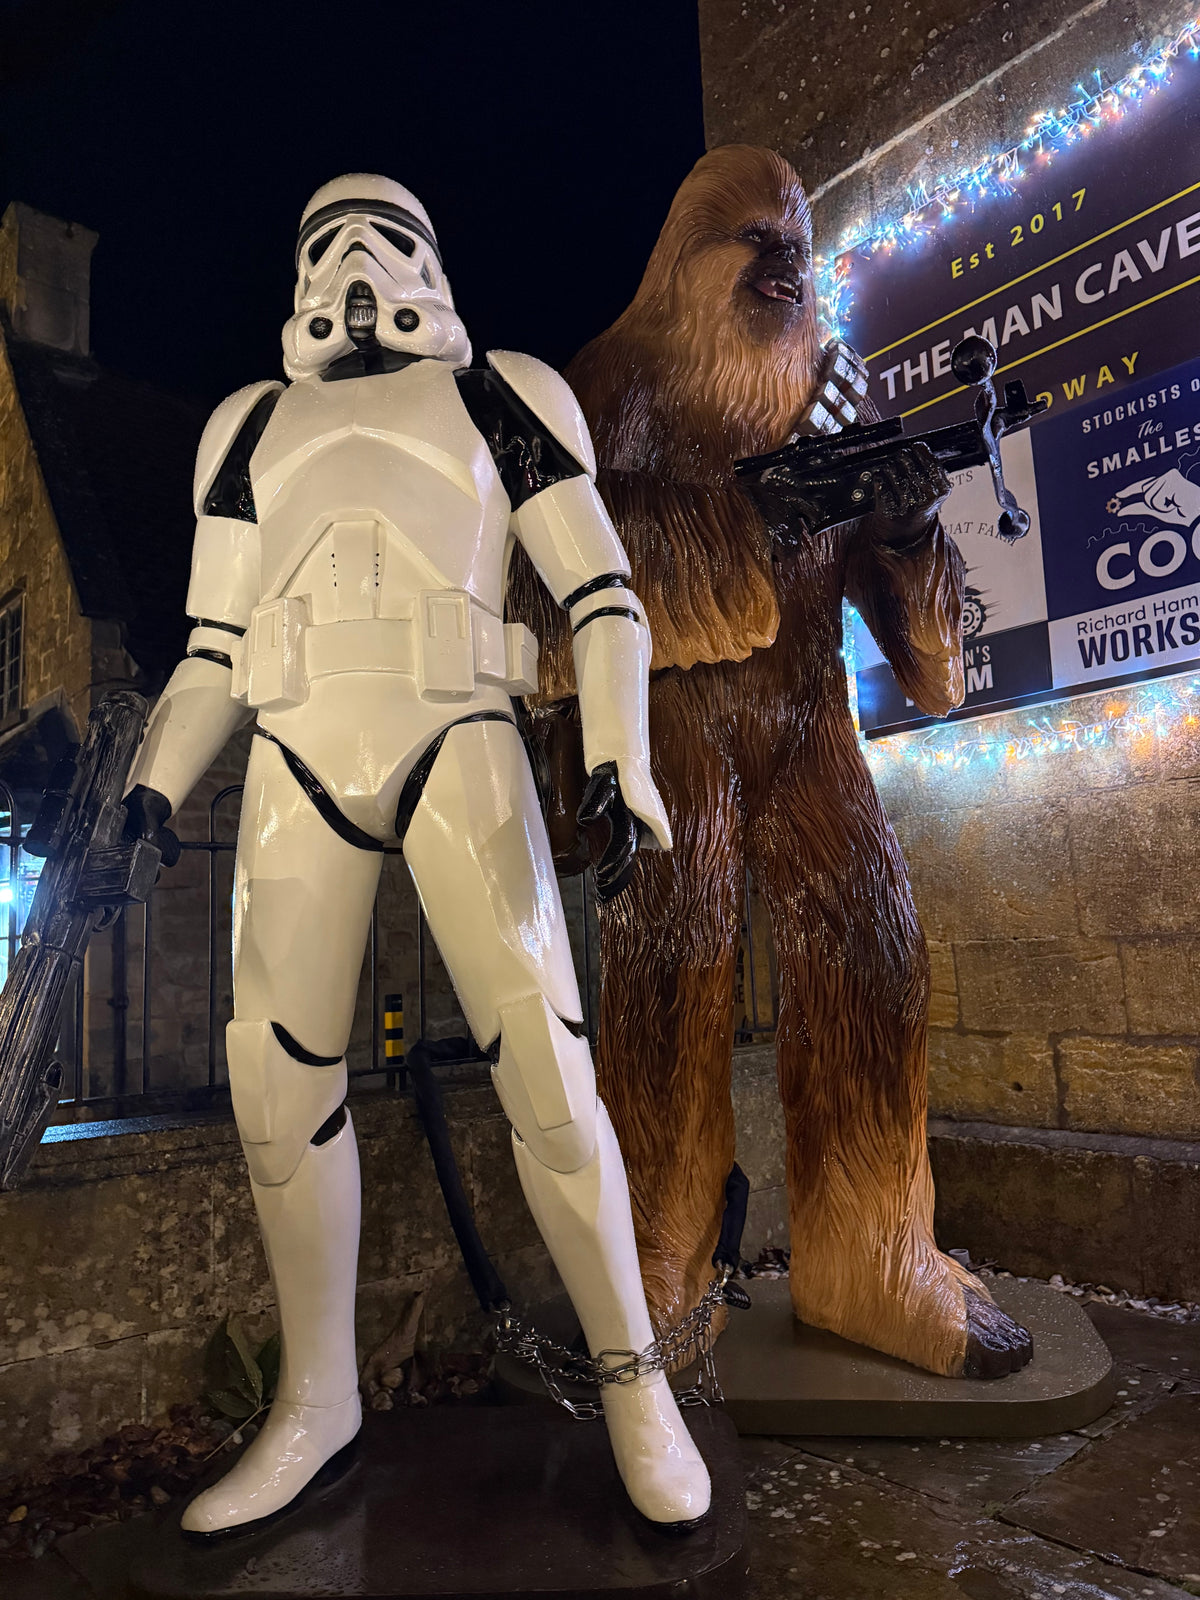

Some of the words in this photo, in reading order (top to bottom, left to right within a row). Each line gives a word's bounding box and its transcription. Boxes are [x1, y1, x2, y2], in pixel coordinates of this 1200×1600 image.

[951, 242, 995, 279] Est
[1010, 188, 1086, 247] 2017
[880, 339, 952, 400] THE
[1075, 211, 1200, 304] CAVE
[1082, 384, 1181, 434] STOCKISTS
[1138, 419, 1164, 439] The
[1096, 522, 1200, 590] CO
[1077, 604, 1146, 636] Richard
[1153, 595, 1199, 617] Ham
[1077, 611, 1200, 669] WORKS
